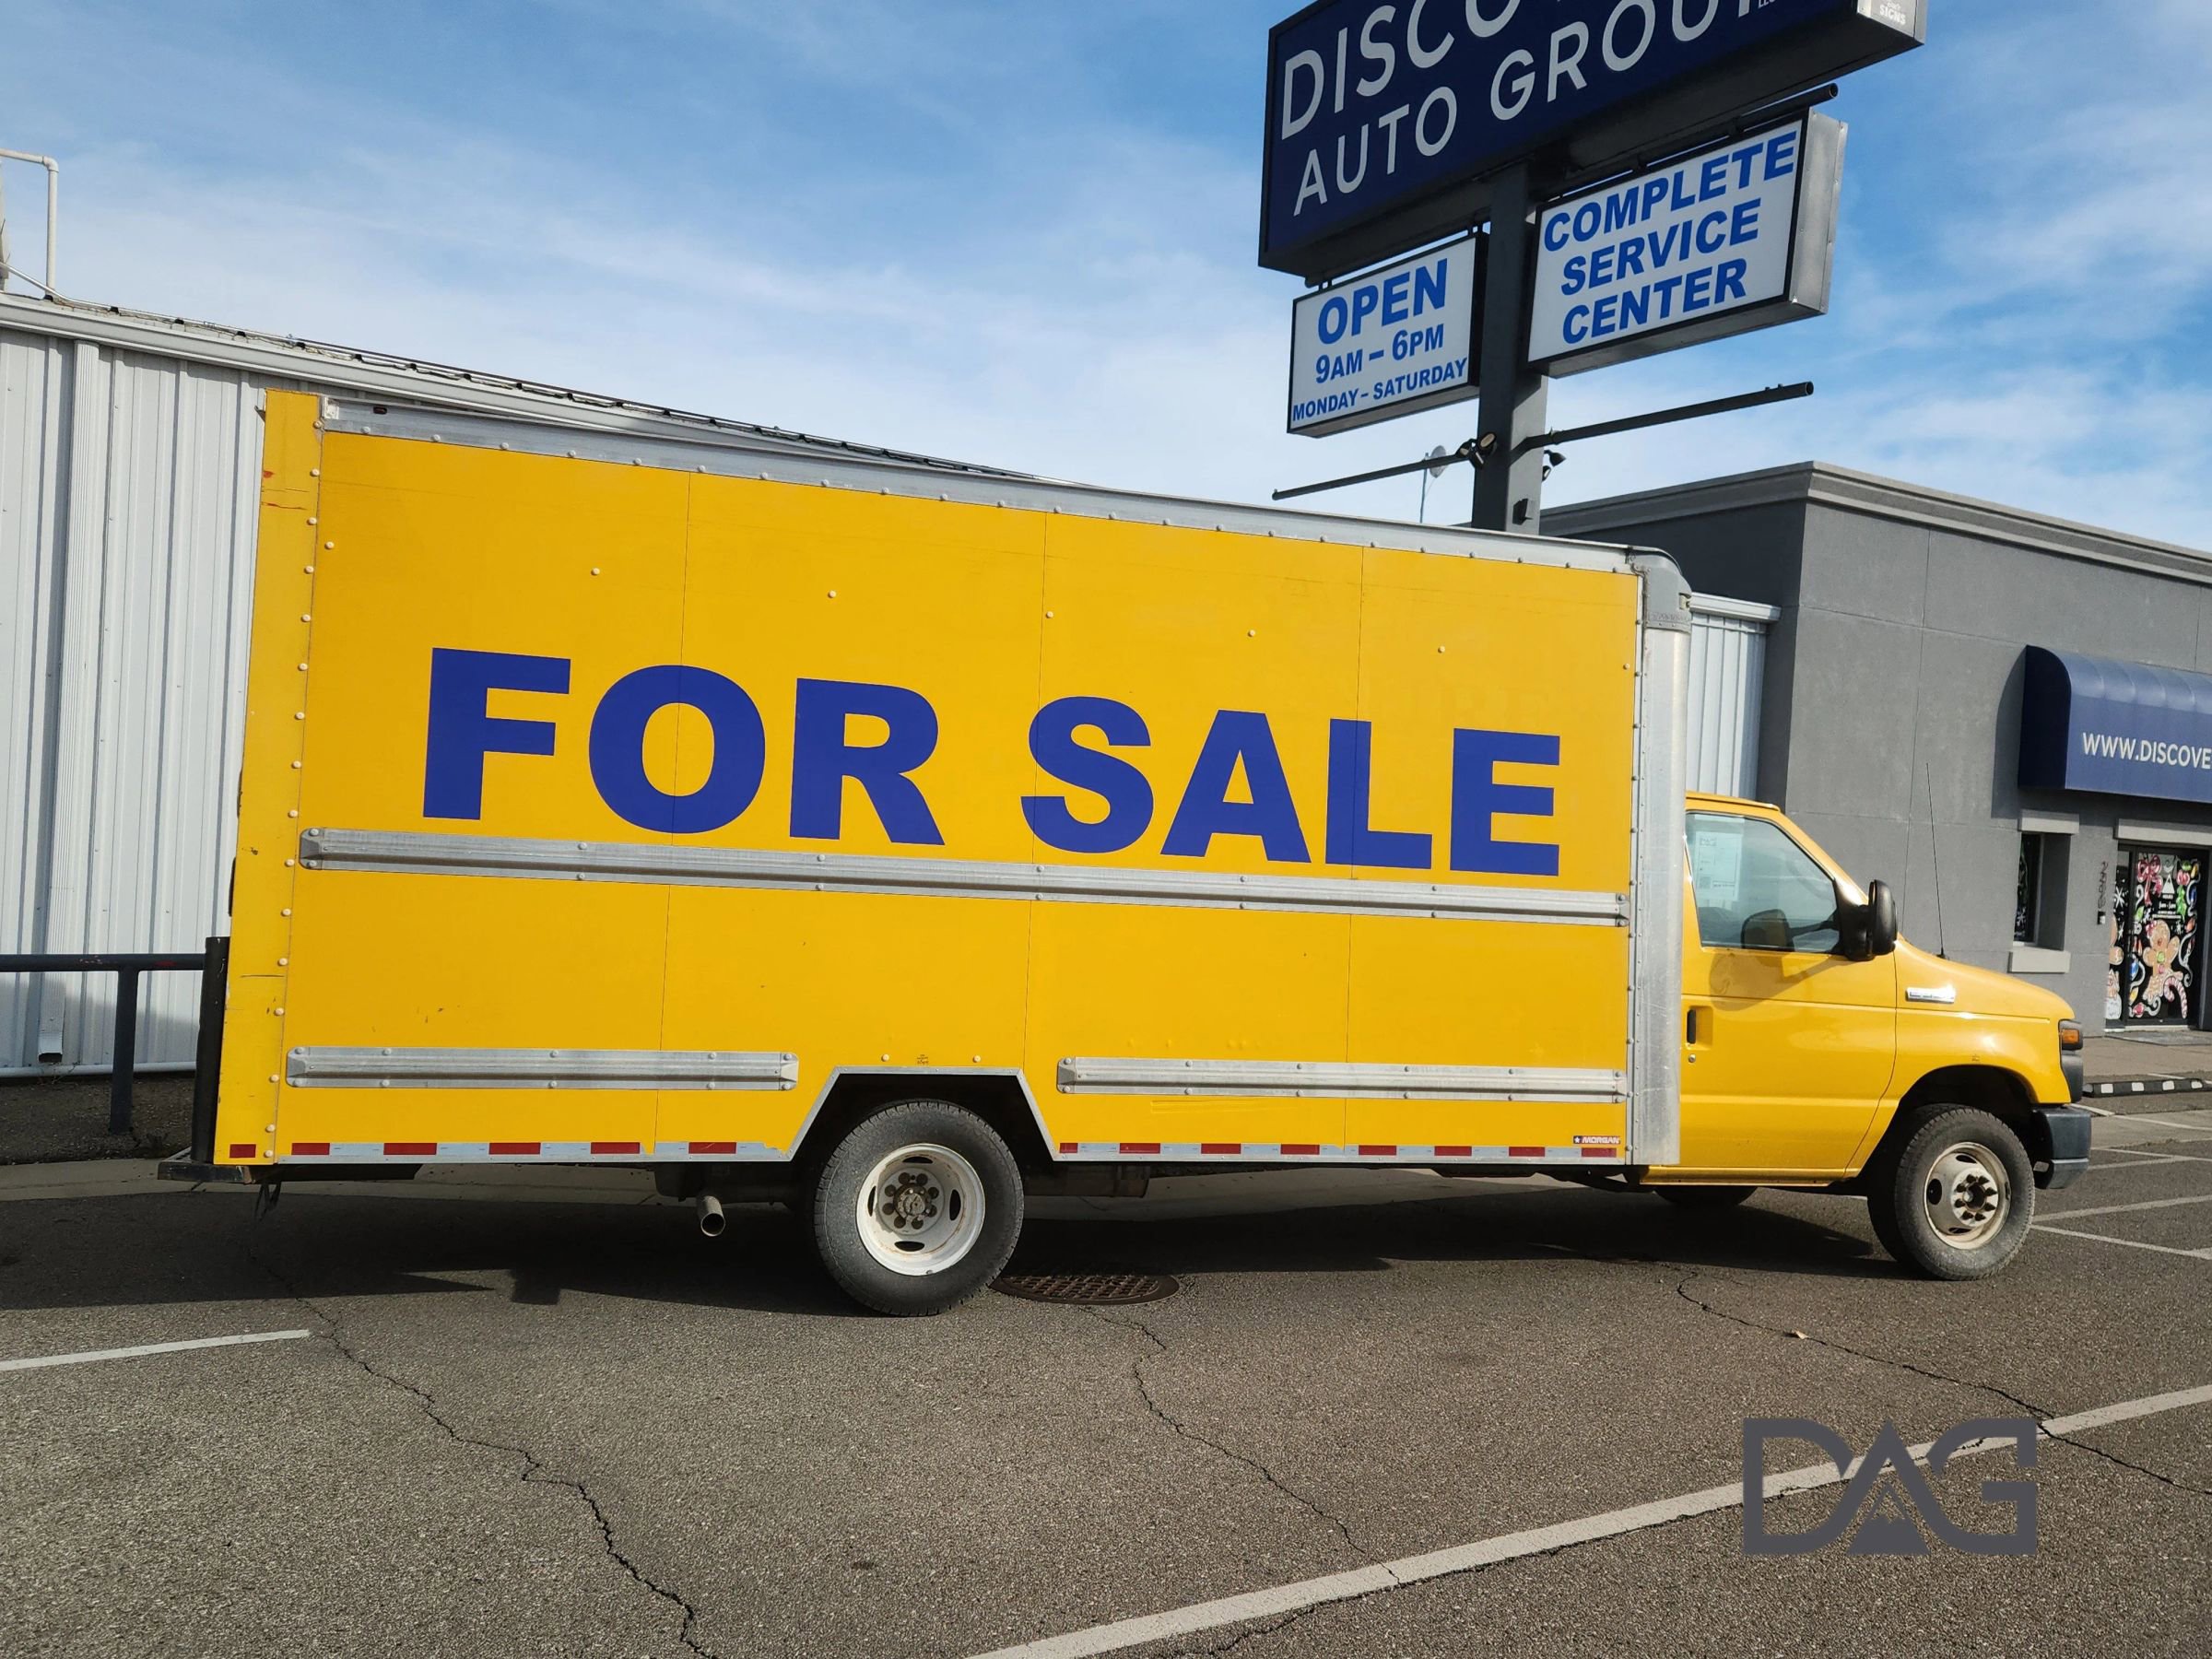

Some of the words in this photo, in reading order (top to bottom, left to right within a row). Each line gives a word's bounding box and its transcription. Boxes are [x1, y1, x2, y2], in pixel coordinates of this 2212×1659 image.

[1879, 4, 1906, 25] SIGNS
[1293, 86, 1458, 217] AUTO
[1490, 0, 1750, 121] GROU
[1544, 131, 1796, 252] COMPLETE
[1560, 198, 1761, 296] SERVICE
[1317, 258, 1448, 345] OPEN
[1562, 258, 1747, 344] CENTER
[1292, 388, 1359, 421] MONDAY
[1373, 358, 1467, 400] SATURDAY
[1315, 349, 1363, 383] 9AM
[1392, 324, 1444, 360] 6PM
[423, 647, 945, 846] FOR
[1020, 696, 1560, 877] SALE
[2083, 732, 2212, 770] WWW.DISCOVE
